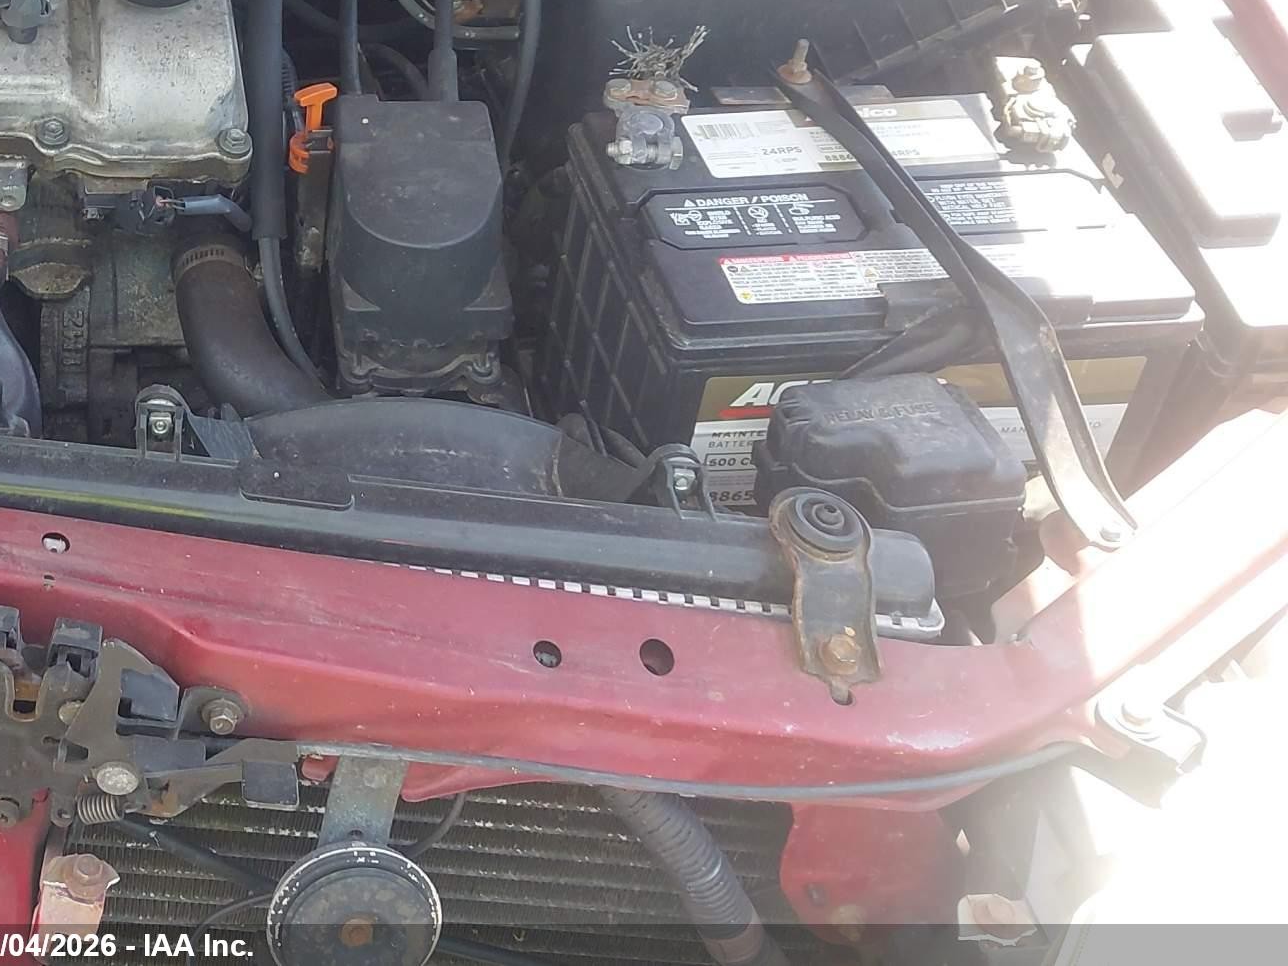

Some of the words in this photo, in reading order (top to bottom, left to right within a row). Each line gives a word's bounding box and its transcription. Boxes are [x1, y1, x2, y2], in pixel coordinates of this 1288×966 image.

[695, 197, 750, 207] DANGER
[760, 193, 809, 203] POISON
[892, 402, 940, 418] FUSE
